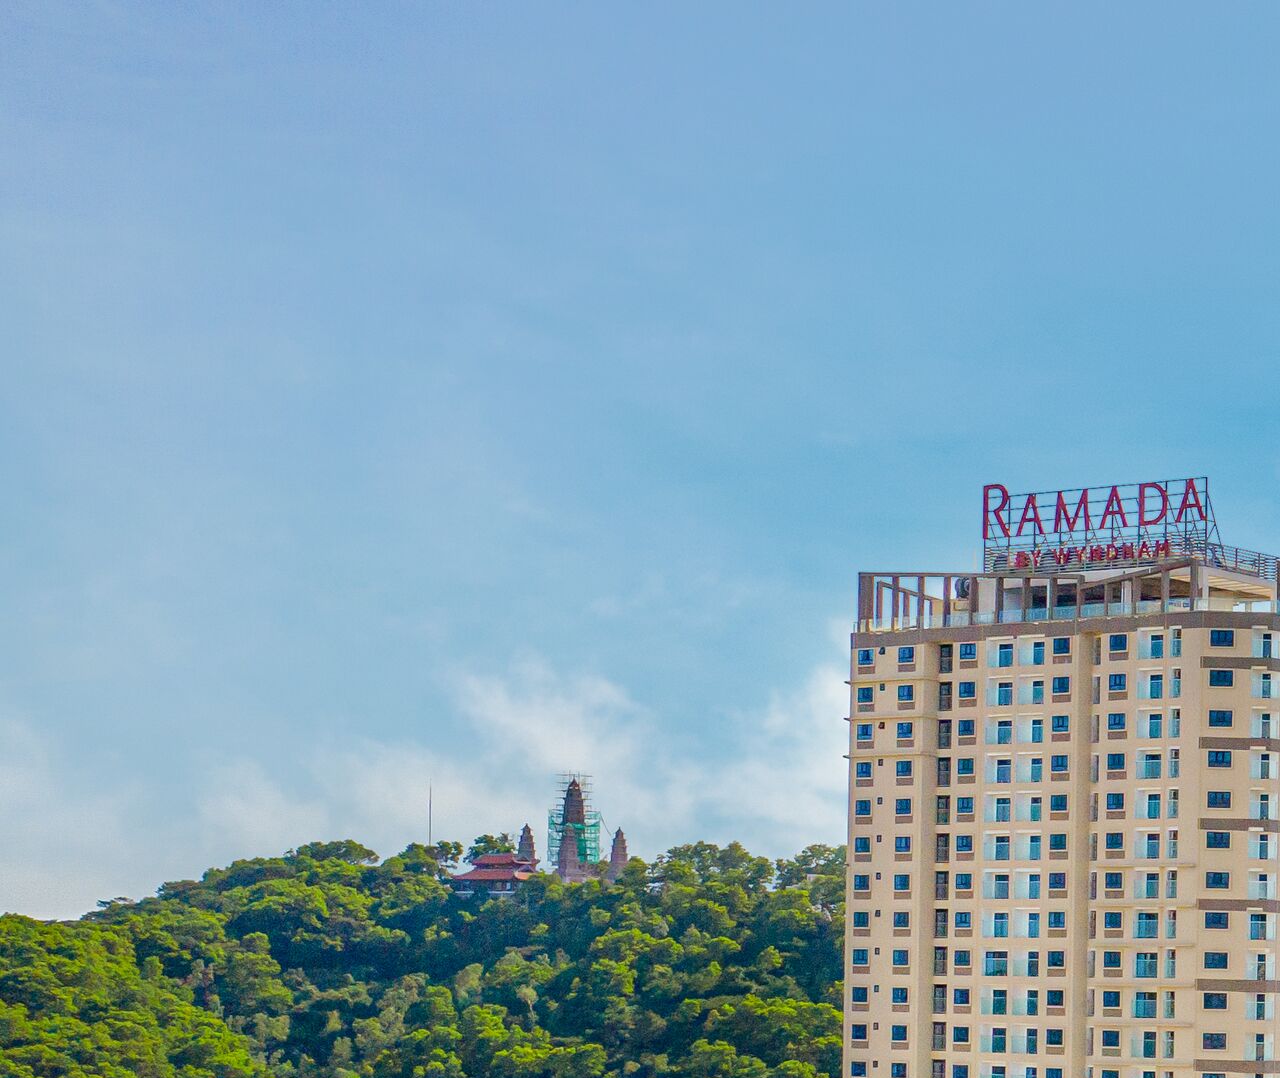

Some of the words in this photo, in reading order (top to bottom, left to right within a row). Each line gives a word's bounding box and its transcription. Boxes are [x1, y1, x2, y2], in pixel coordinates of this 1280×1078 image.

[983, 478, 1206, 539] RAMADA
[1014, 549, 1041, 568] BY
[1053, 540, 1170, 566] WYNDHAM
